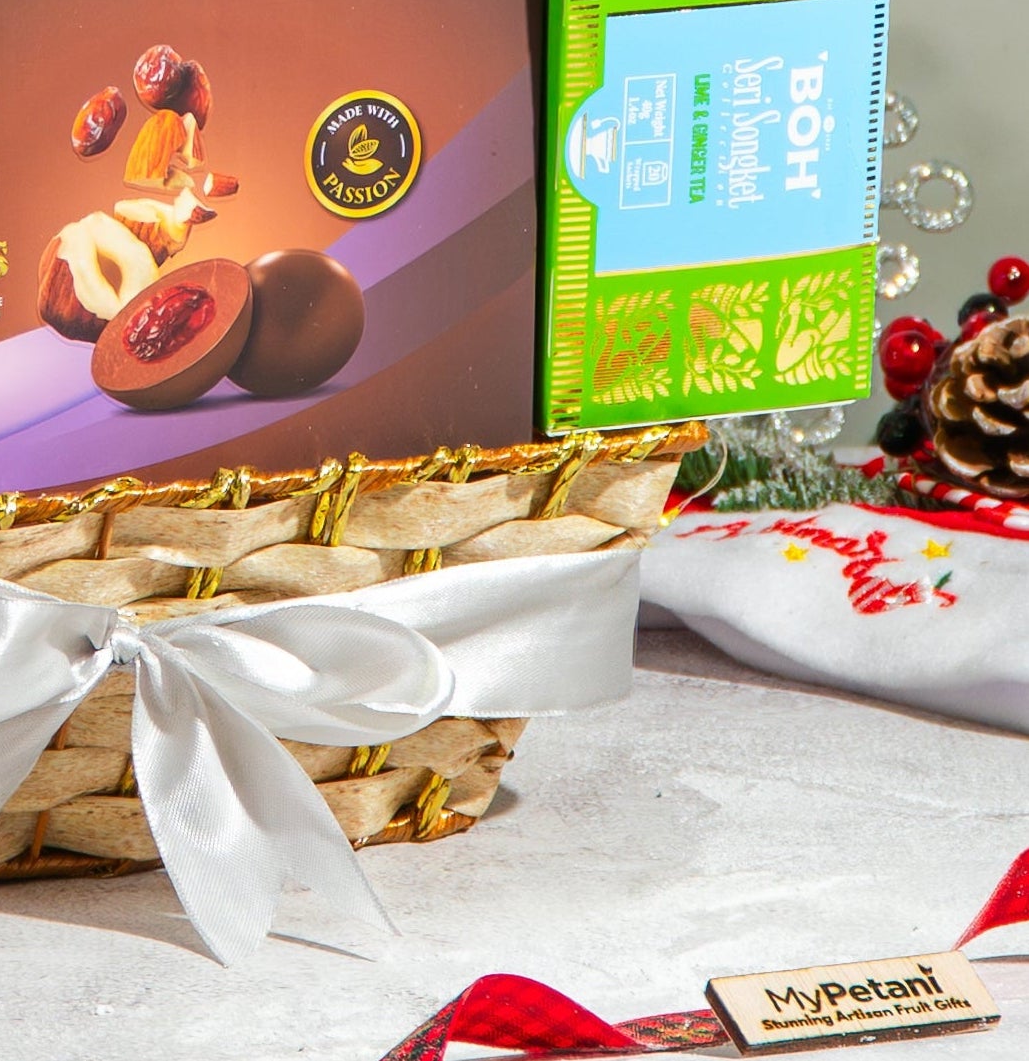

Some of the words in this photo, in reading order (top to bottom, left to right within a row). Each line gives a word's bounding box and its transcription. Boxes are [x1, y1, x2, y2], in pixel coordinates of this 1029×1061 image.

[694, 73, 710, 106] LIME
[733, 56, 784, 107] Seri
[326, 105, 363, 135] MADE
[367, 104, 400, 129] WITH
[693, 110, 709, 121] &
[785, 63, 824, 191] BOH
[690, 124, 708, 175] GINGER
[719, 110, 781, 209] Songket
[322, 167, 401, 204] PASSION
[689, 177, 706, 204] TEA
[764, 963, 944, 1014] MyPetani
[763, 1013, 833, 1031] Stunning
[837, 1007, 893, 1022] Artisan
[895, 1001, 933, 1016] Fruit
[934, 997, 972, 1011] Gifts
